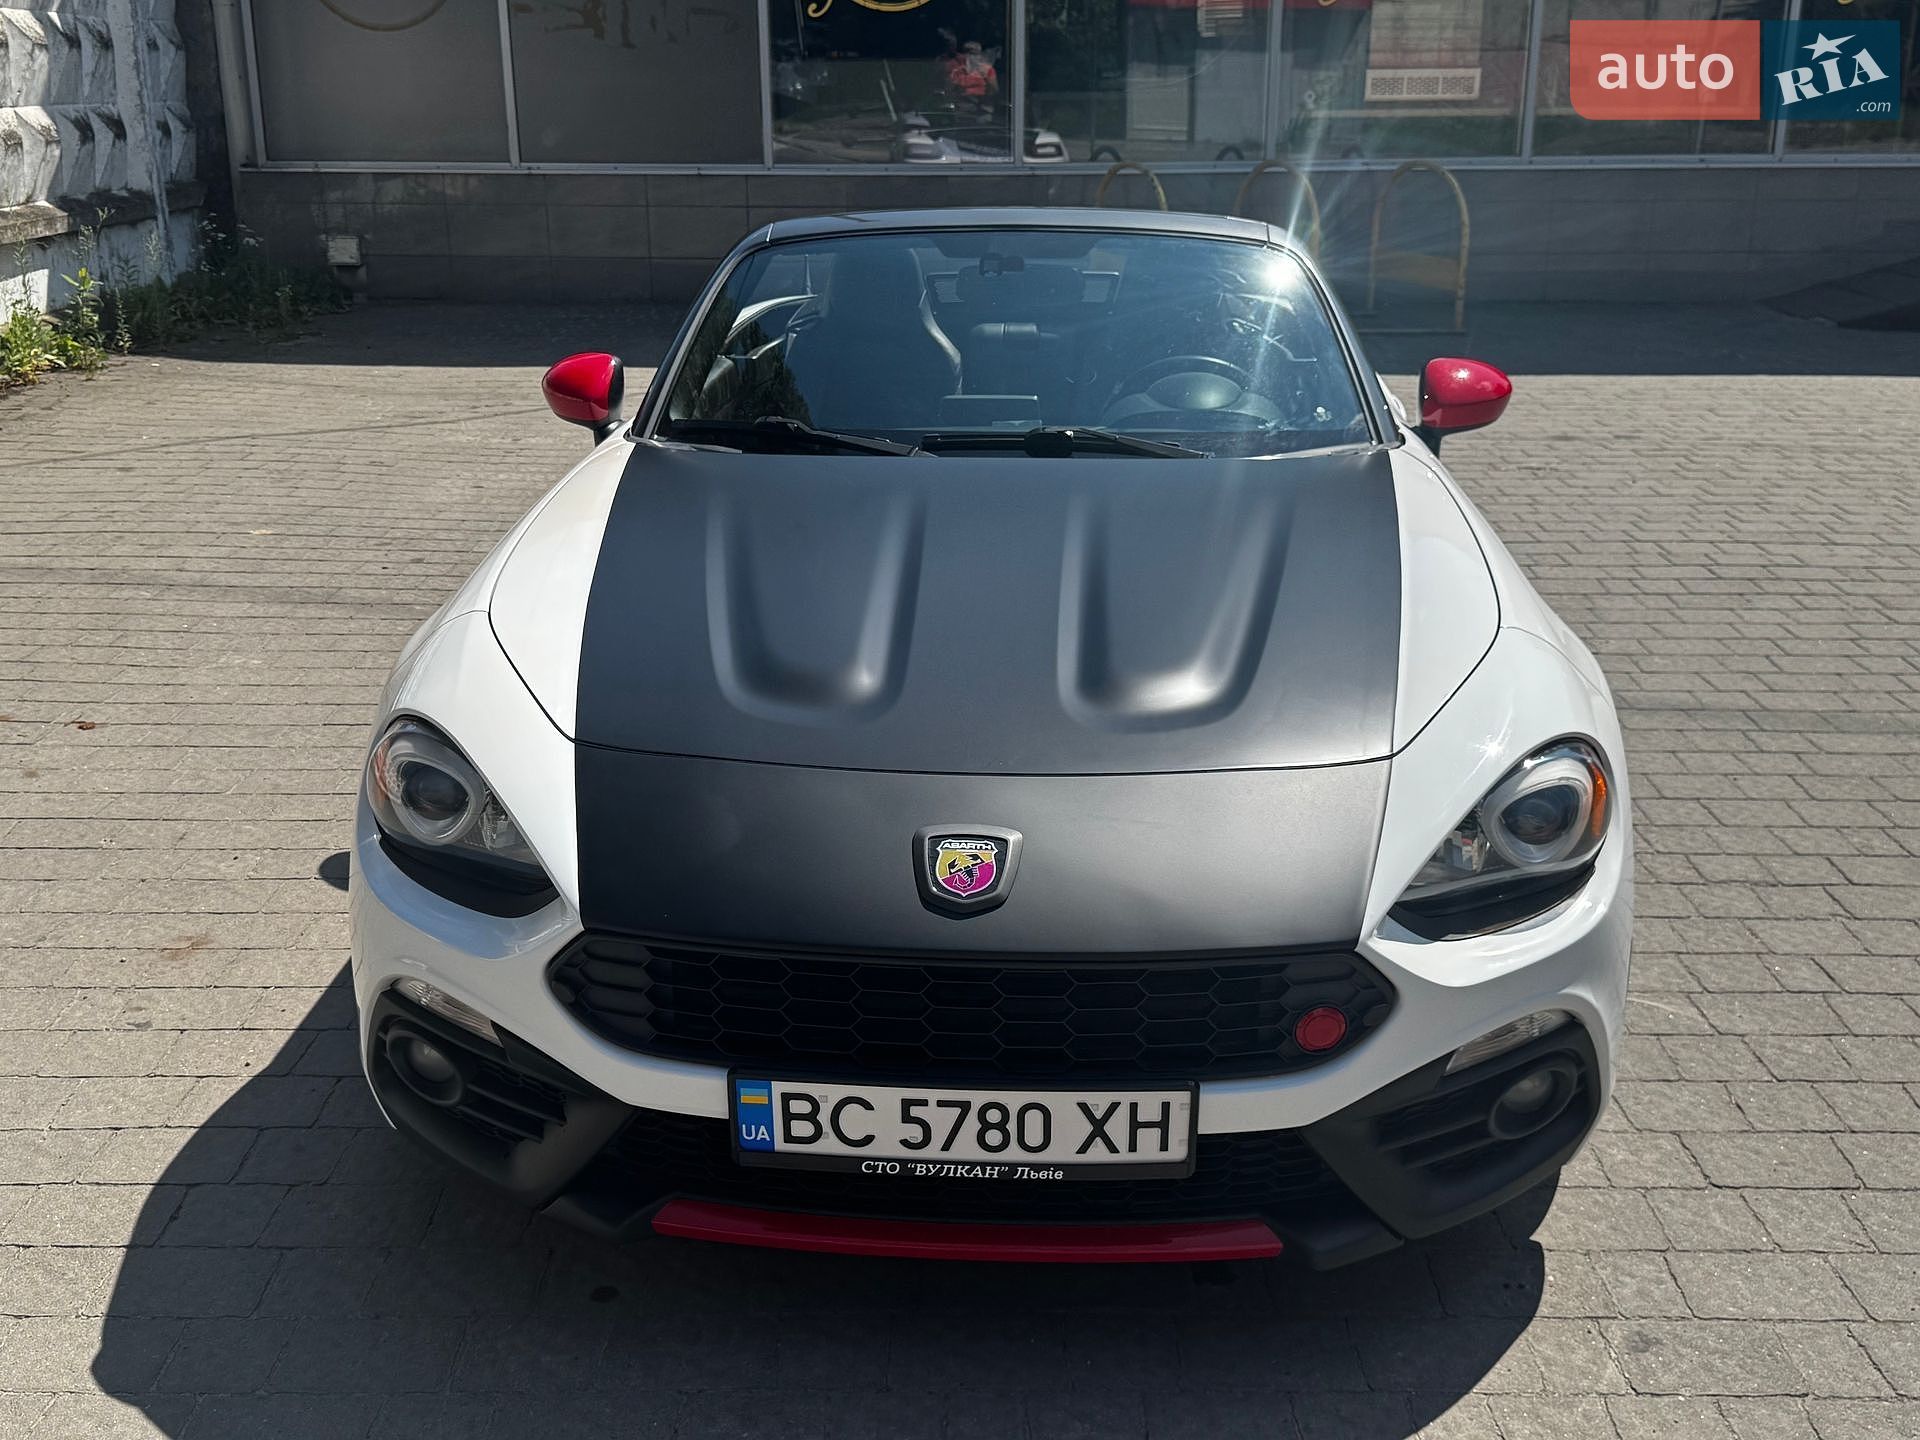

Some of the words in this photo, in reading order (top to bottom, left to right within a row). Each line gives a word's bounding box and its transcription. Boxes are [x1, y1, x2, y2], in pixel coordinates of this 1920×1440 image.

[942, 842, 992, 850] ABARTH
[779, 1091, 876, 1148] BC
[898, 1098, 1053, 1154] 5780
[1075, 1101, 1171, 1155] XH
[741, 1124, 771, 1142] UA
[861, 1160, 900, 1175] СТО
[1013, 1166, 1064, 1180] Львів
